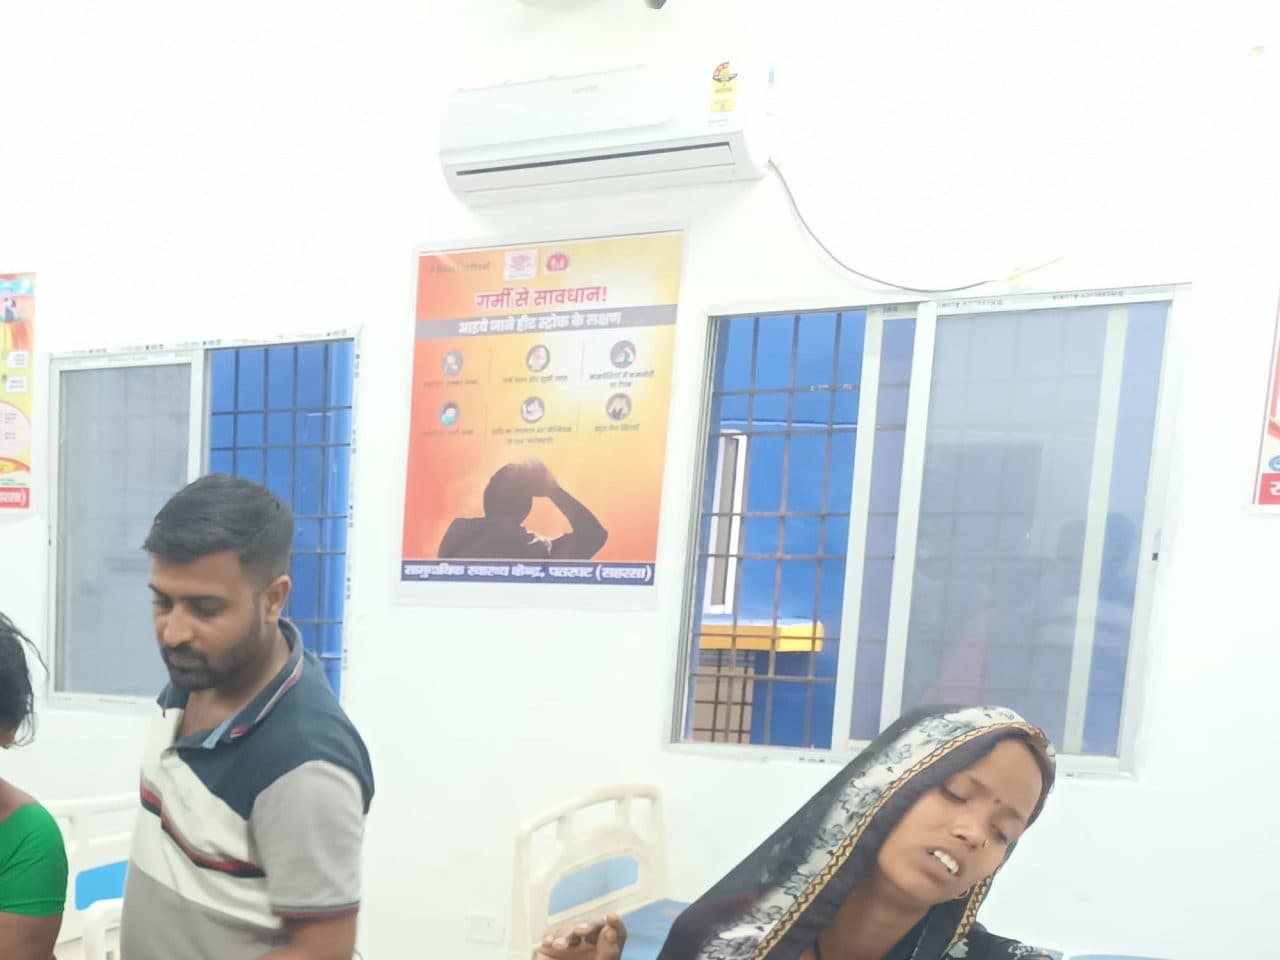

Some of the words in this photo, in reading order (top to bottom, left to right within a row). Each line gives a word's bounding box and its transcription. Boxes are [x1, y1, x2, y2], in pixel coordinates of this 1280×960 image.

[476, 286, 514, 310] गर्मी
[516, 287, 530, 308] से
[534, 285, 608, 307] सावधान!
[517, 315, 536, 333] हीट
[572, 312, 584, 328] के
[586, 311, 621, 327] लक्षण
